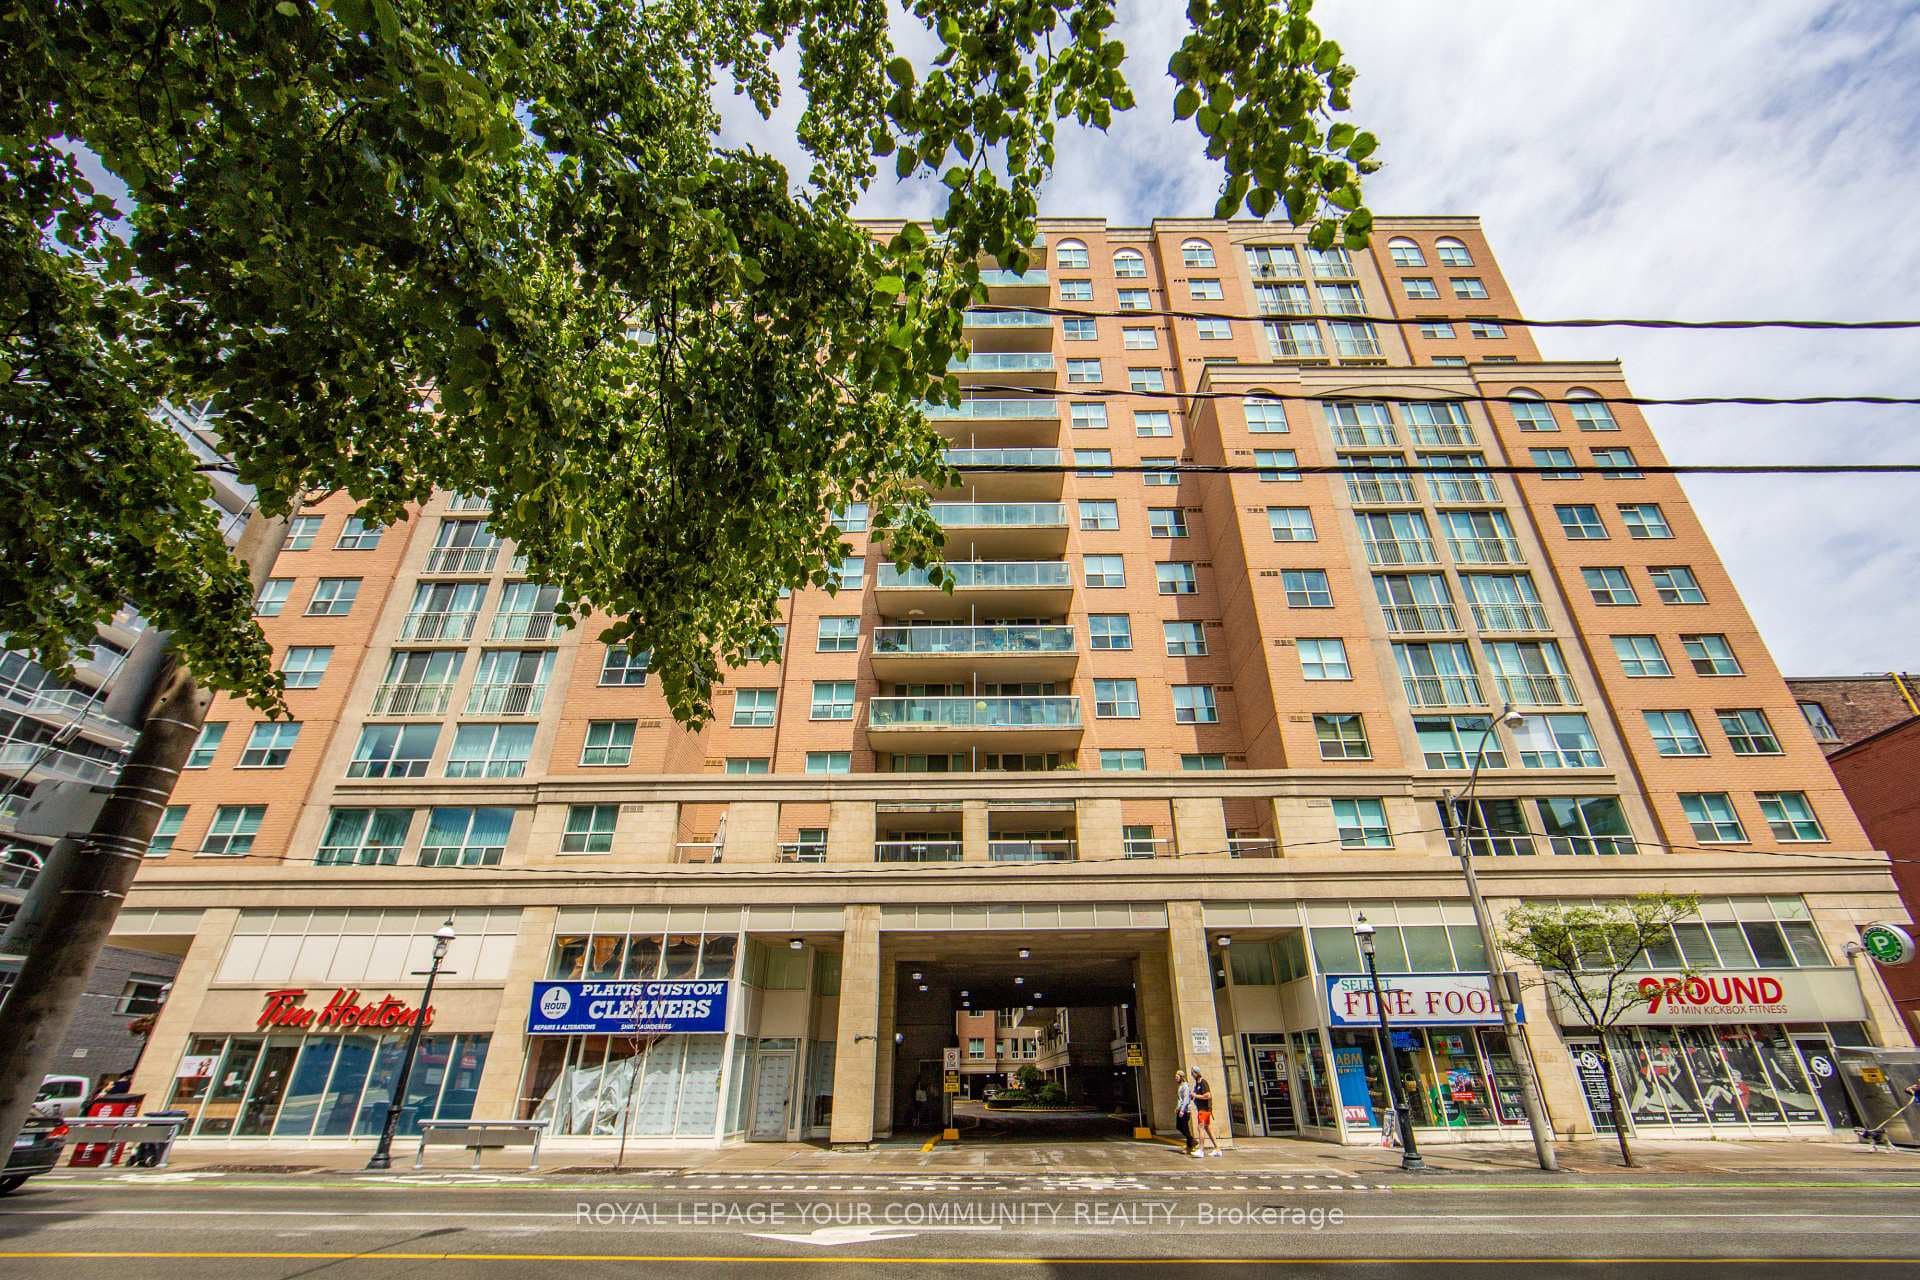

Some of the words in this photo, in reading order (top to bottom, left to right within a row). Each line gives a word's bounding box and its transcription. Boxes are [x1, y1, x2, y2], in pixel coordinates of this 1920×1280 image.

[580, 984, 643, 997] PLATIS
[646, 983, 724, 996] CUSTOM
[1341, 979, 1392, 991] SELET
[554, 989, 561, 1001] 1
[1638, 976, 1783, 1014] 9ROUND
[256, 989, 317, 1027] Tim
[317, 986, 434, 1027] Hortons
[543, 1002, 568, 1011] HOUR
[588, 999, 713, 1019] CLEANERS
[1668, 1006, 1680, 1015] 30
[1682, 1005, 1702, 1015] MIN
[1704, 1005, 1747, 1015] KICKBOX
[1749, 1004, 1788, 1014] FITNESS
[1336, 1053, 1363, 1065] ABM
[1343, 1108, 1369, 1119] ATM
